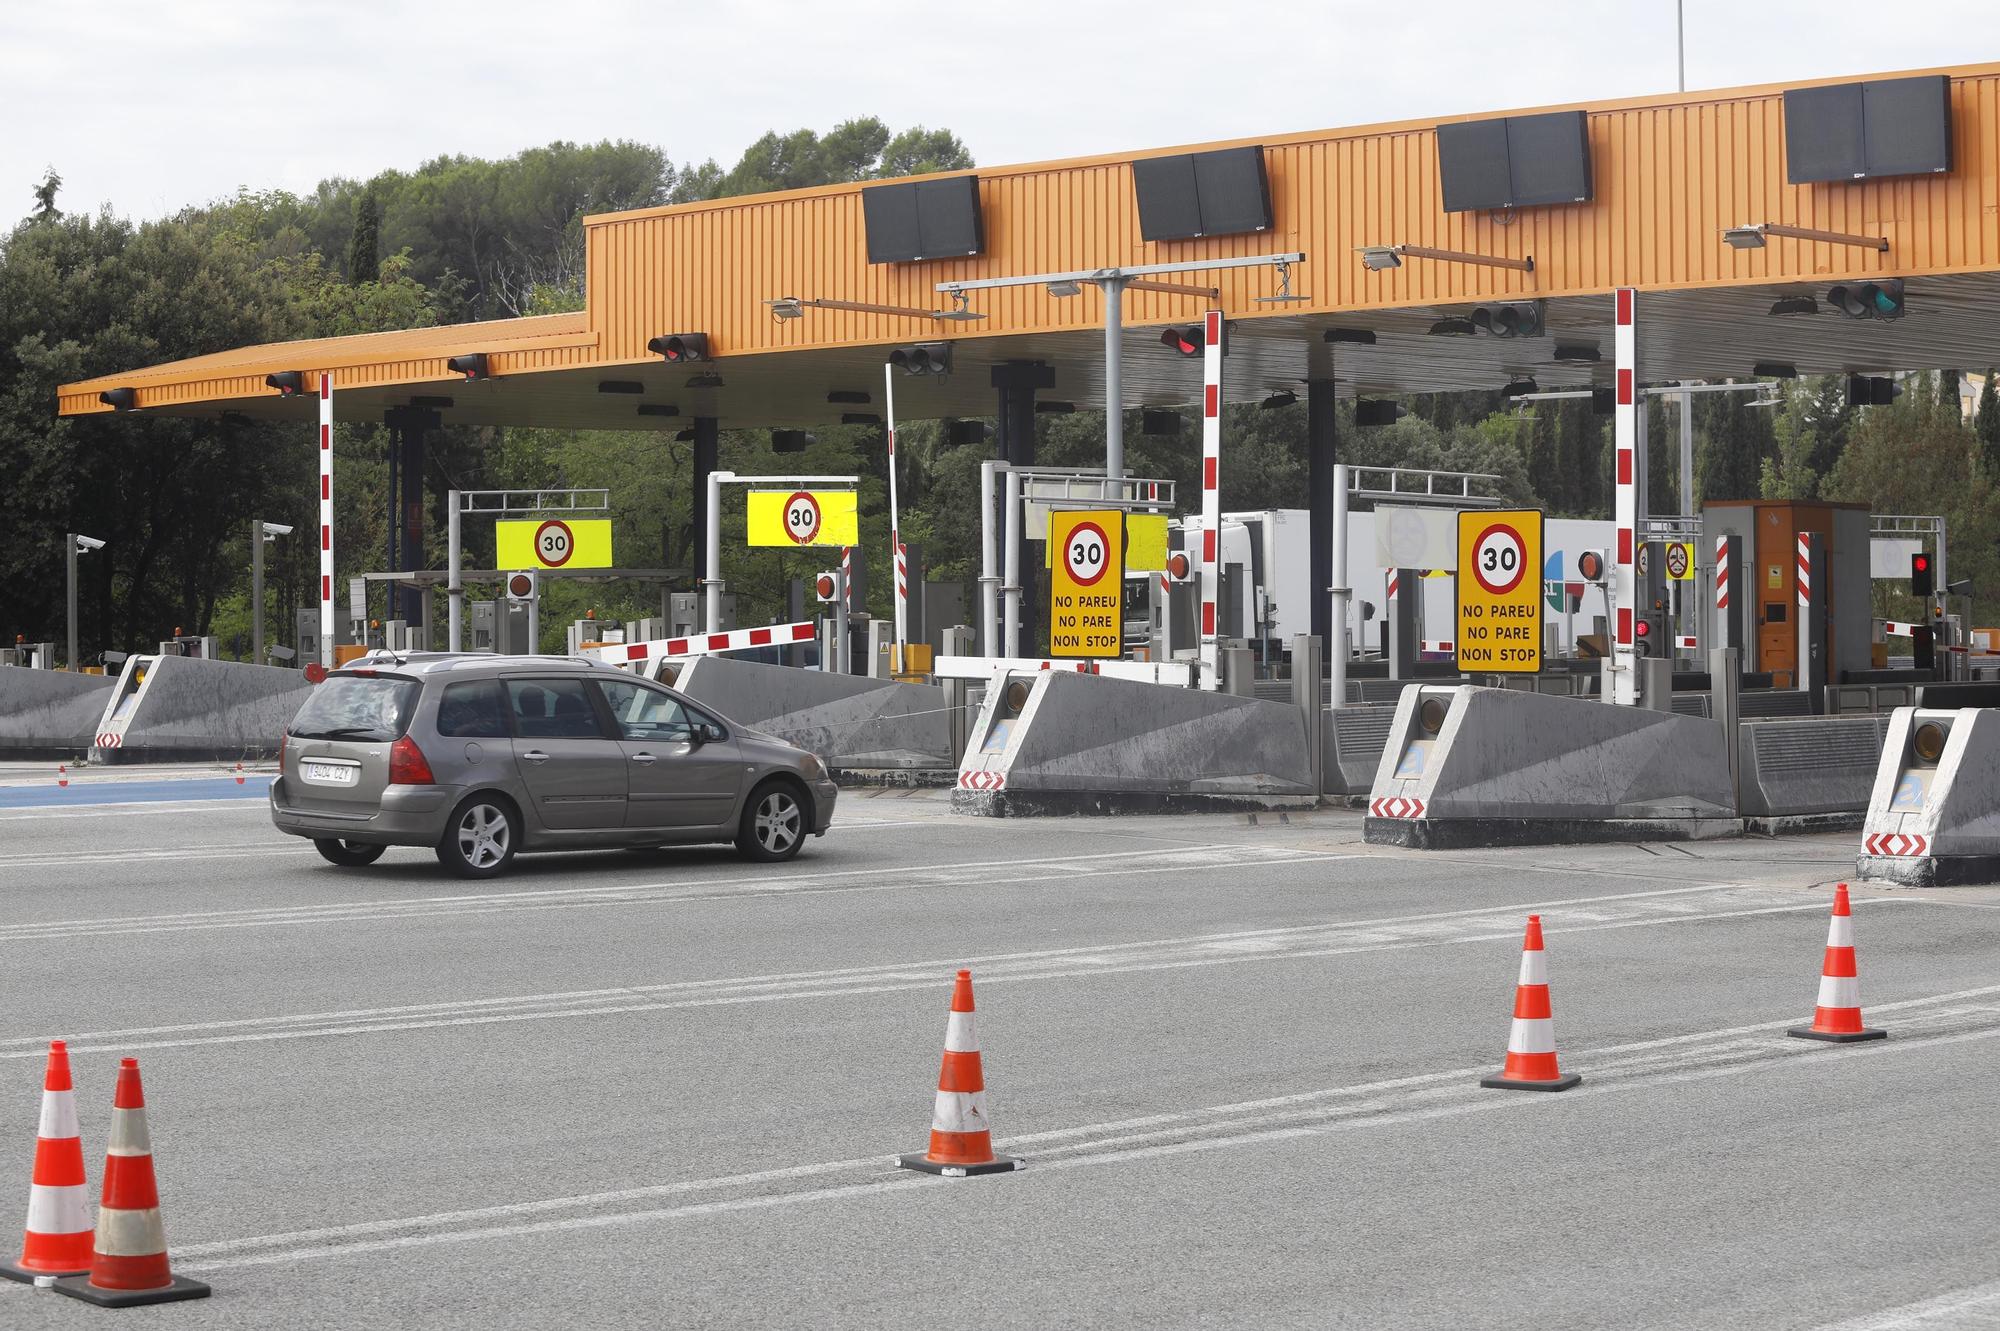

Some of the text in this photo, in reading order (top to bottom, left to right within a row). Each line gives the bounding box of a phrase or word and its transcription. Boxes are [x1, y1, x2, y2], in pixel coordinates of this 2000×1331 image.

[790, 508, 813, 526] 30
[543, 535, 566, 551] 30
[1073, 543, 1101, 565] 30
[1483, 547, 1516, 571] 30
[1055, 596, 1116, 608] NO PAREU
[1463, 605, 1535, 618] NO PAREU
[1059, 615, 1112, 627] NO PARE
[1468, 626, 1530, 639] NO PARE
[1053, 635, 1117, 648] NON STOP
[1461, 648, 1536, 662] NON STOP
